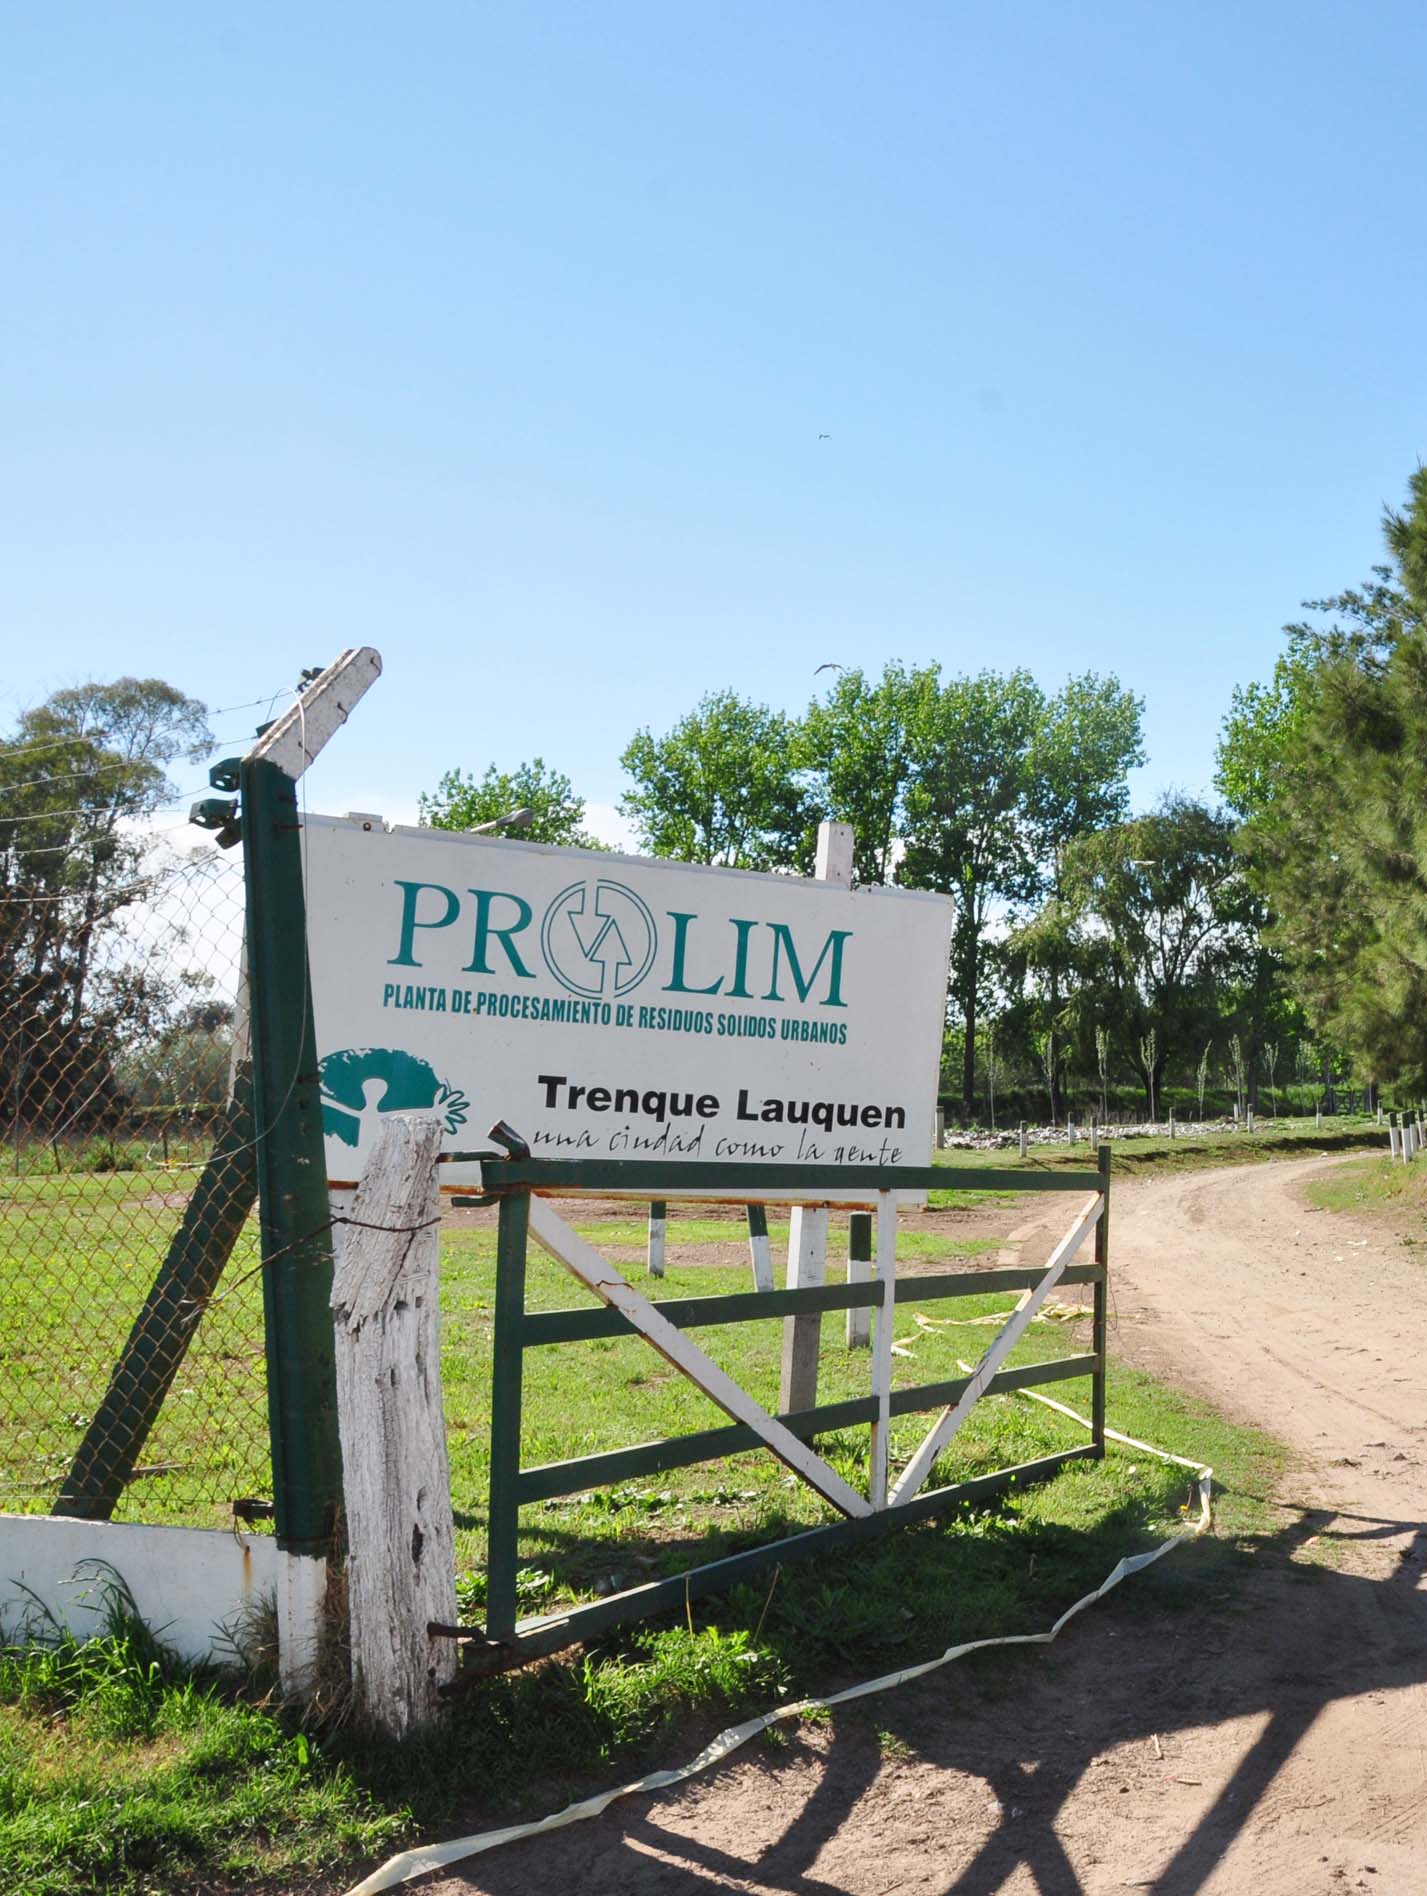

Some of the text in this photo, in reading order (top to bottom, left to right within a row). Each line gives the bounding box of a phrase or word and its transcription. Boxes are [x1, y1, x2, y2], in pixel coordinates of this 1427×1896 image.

[383, 983, 848, 1046] PLANTA DE PROCESAMIENTO DE RESIDUOS SOLIDOS URBANOS
[538, 1074, 906, 1132] Trenque Lauquen
[533, 1128, 600, 1149] una
[609, 1121, 705, 1157] ciudad
[715, 1137, 785, 1158] como
[796, 1127, 824, 1160] la
